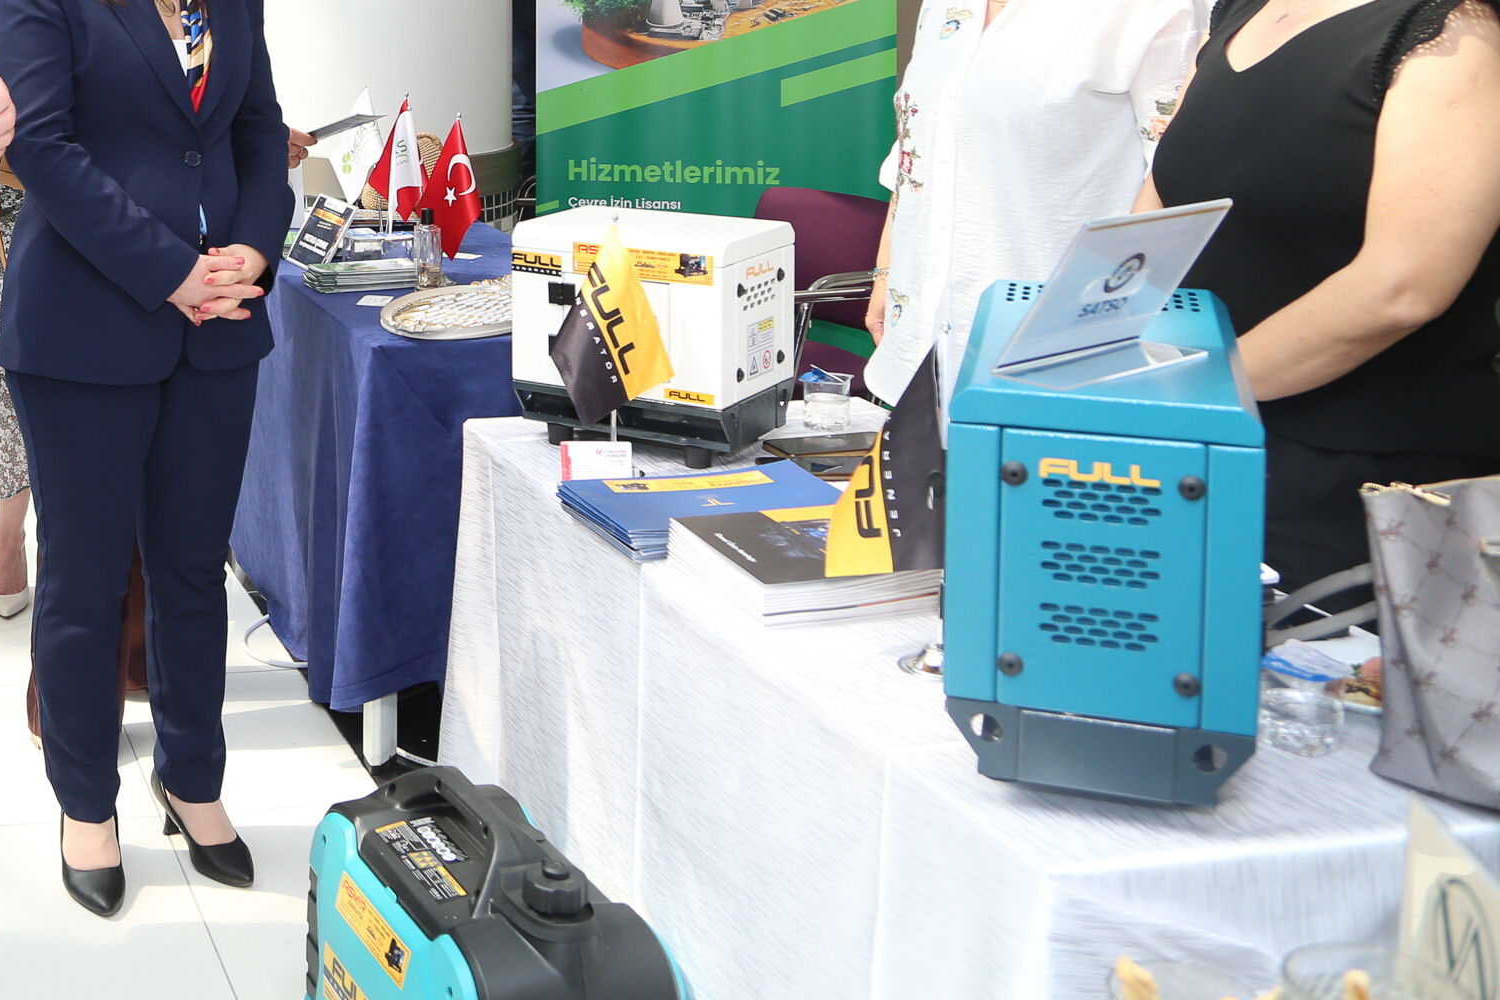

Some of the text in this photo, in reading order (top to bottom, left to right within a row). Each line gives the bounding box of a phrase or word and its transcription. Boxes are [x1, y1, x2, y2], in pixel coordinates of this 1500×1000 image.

[568, 157, 780, 185] Hizmetlerimiz
[610, 195, 633, 209] İzin
[635, 197, 681, 210] Lisansı
[577, 244, 598, 255] AS
[511, 253, 561, 268] FULL
[746, 261, 775, 280] FULL
[588, 262, 635, 375] FULL
[669, 391, 706, 402] FULL
[1039, 457, 1161, 488] FULL
